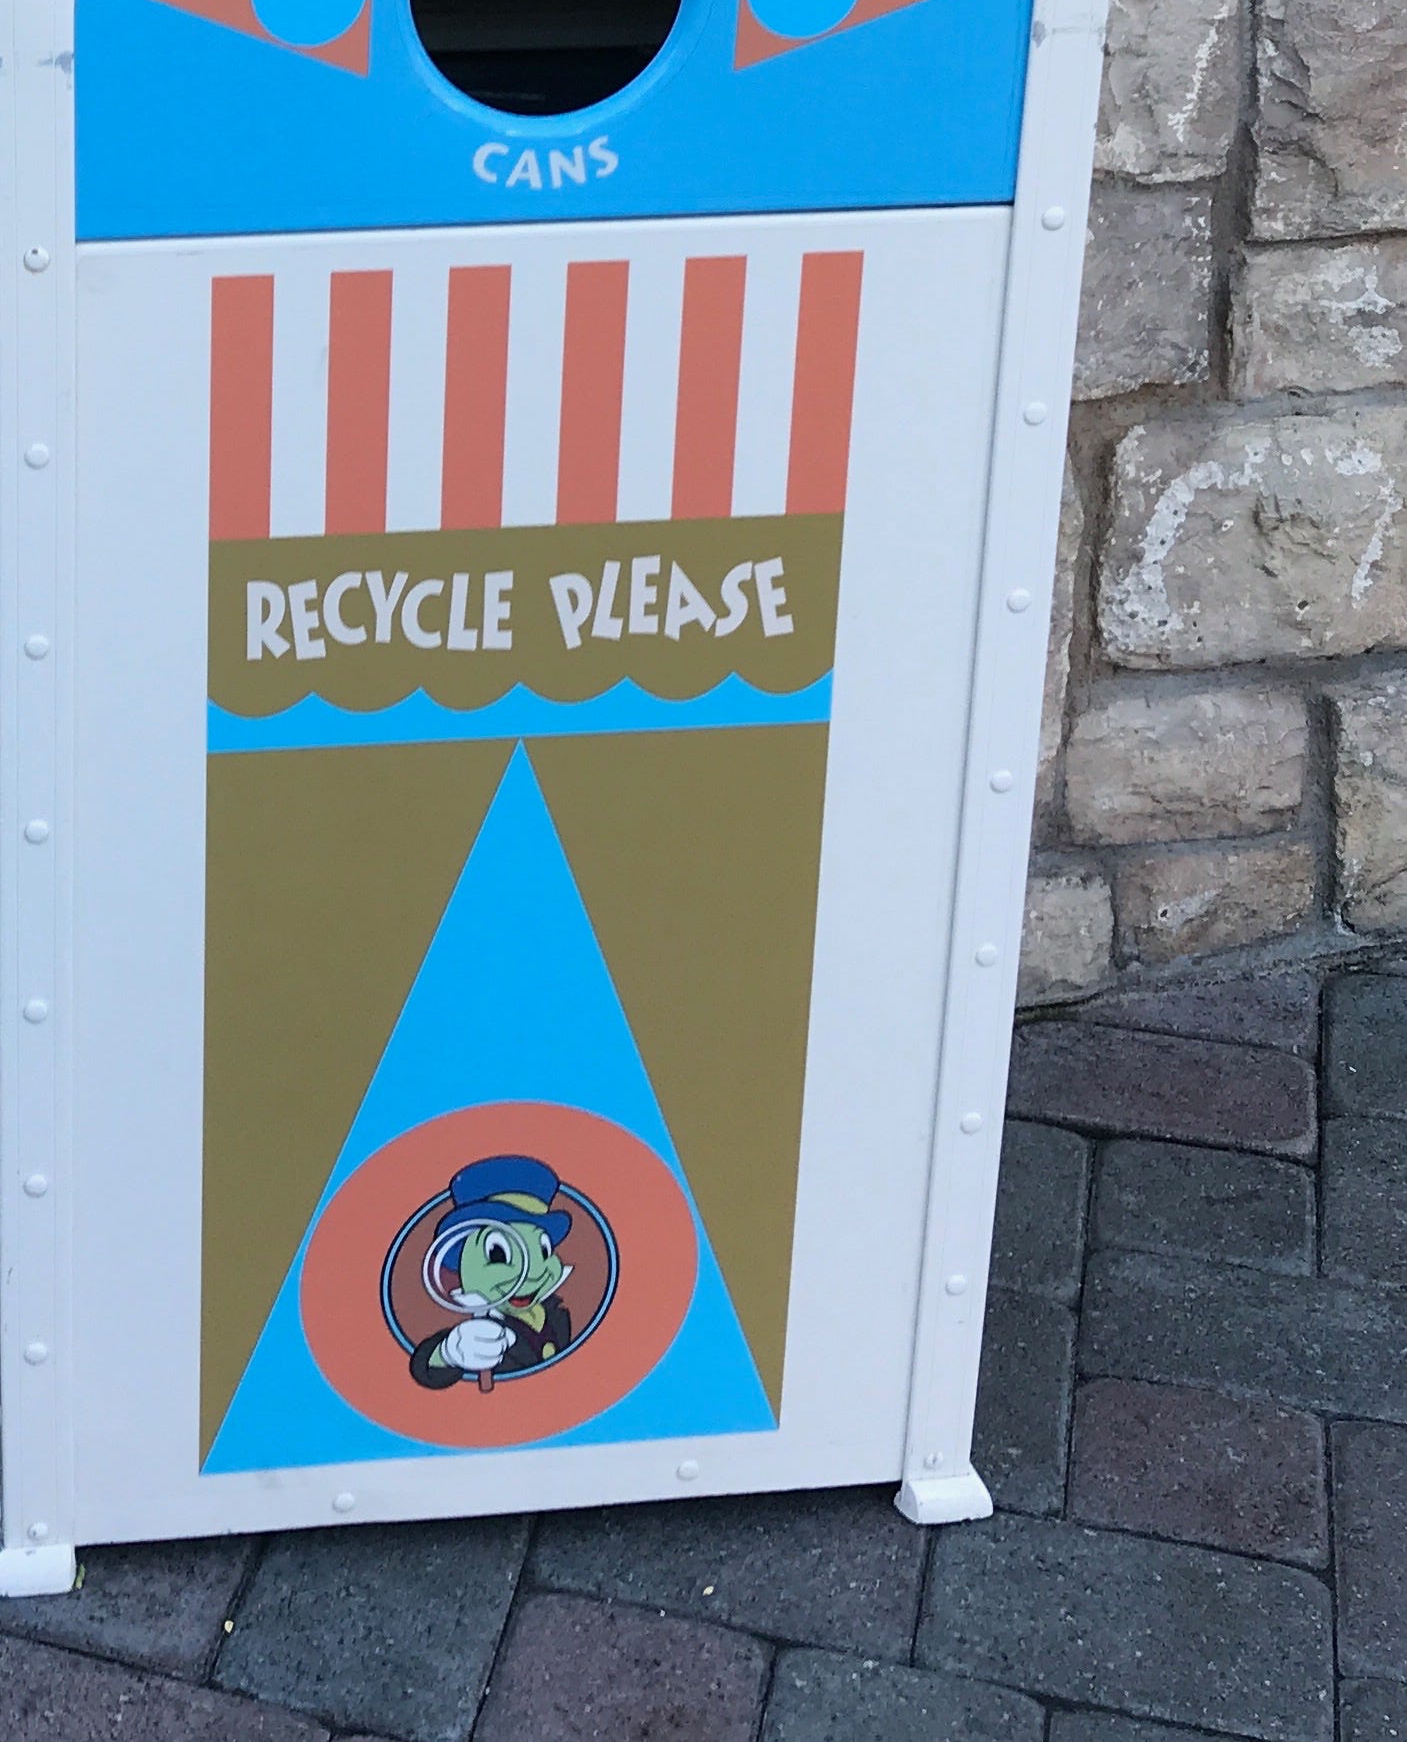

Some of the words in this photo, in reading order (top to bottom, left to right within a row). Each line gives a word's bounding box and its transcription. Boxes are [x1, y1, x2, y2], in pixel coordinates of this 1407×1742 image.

[472, 135, 619, 190] CANS
[246, 570, 514, 661] RECYCLE
[548, 554, 794, 650] PLEASE
